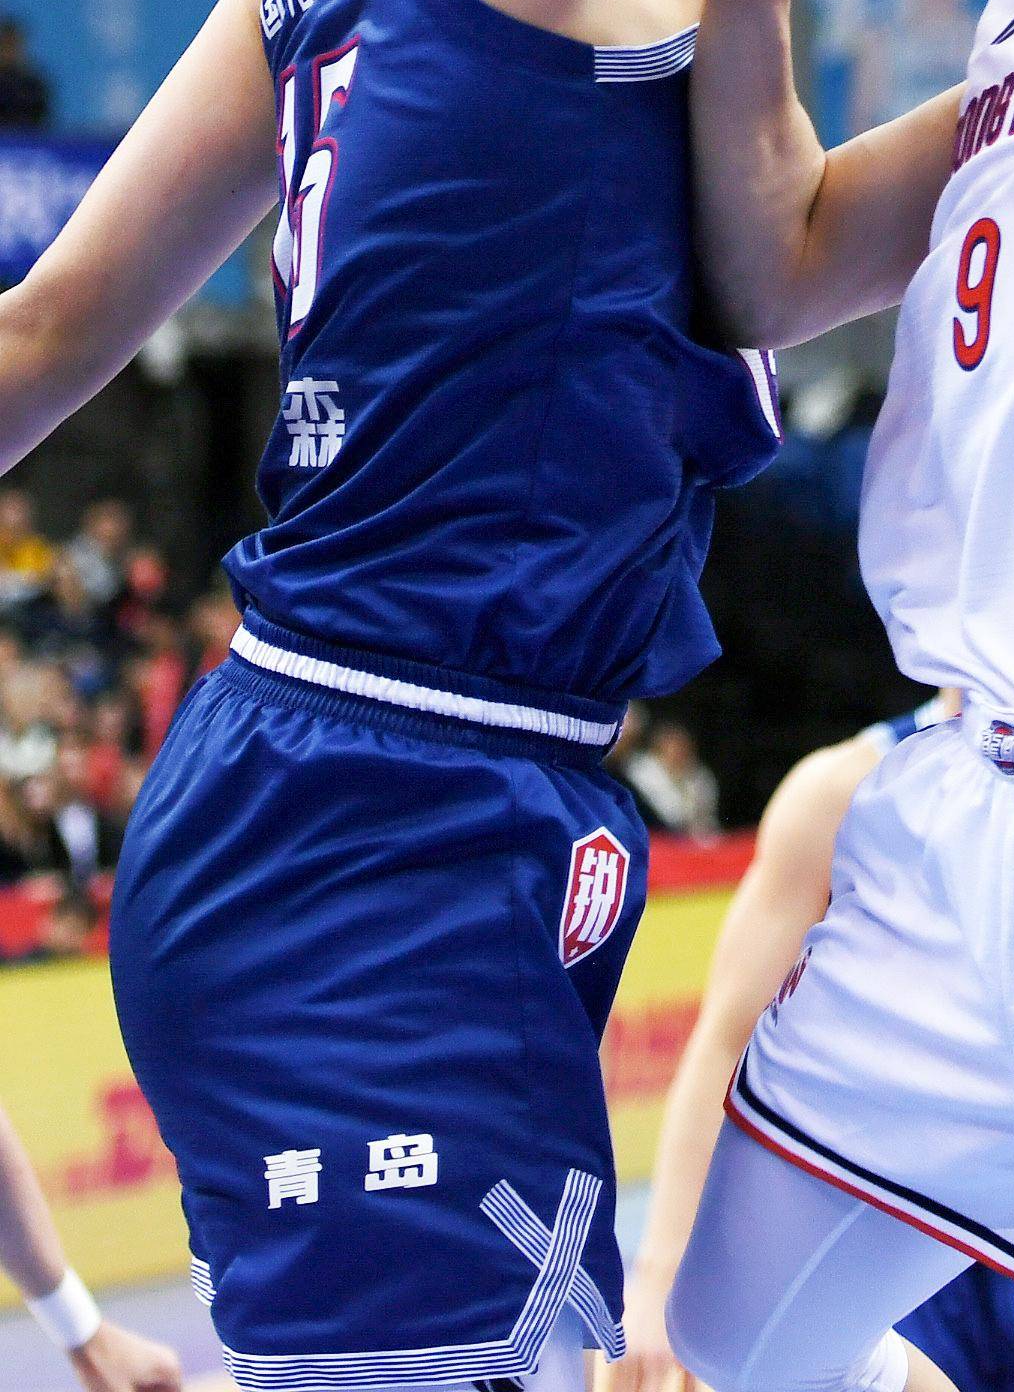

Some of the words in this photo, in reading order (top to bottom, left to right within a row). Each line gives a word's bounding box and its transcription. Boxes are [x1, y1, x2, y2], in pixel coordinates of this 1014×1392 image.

[953, 216, 1002, 373] 9
[282, 376, 346, 468] 森
[263, 1133, 439, 1210] 青岛
